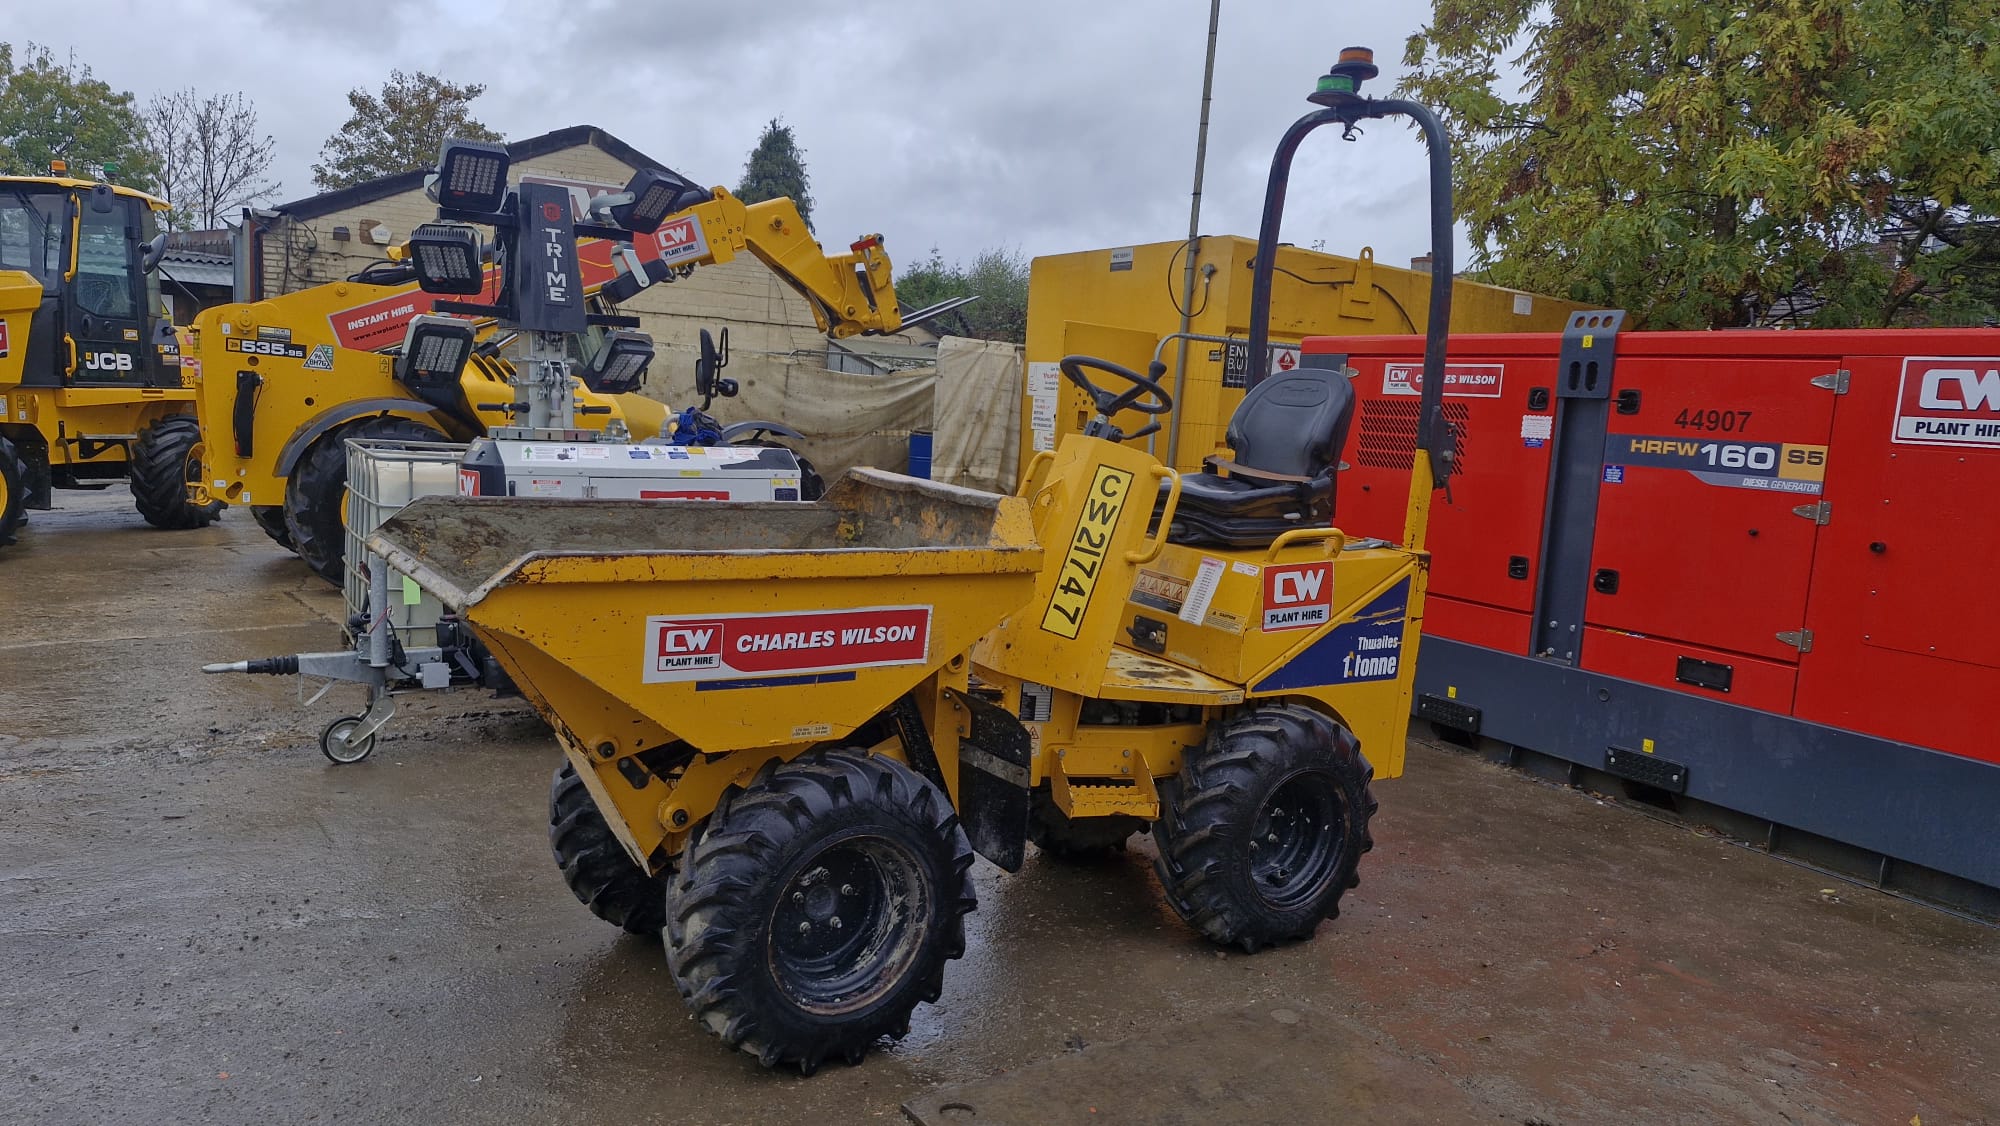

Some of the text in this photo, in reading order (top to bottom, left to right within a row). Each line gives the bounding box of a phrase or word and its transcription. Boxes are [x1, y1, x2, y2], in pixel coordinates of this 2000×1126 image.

[657, 225, 687, 248] CW
[546, 228, 567, 302] TRIME
[347, 304, 415, 331] INSTANT HIRE
[86, 352, 133, 371] JCB
[1458, 375, 1496, 385] WILSON
[1919, 369, 2000, 411] CW
[1674, 408, 1752, 432] 44907
[1914, 421, 2000, 438] PLANT HIR
[1630, 439, 1824, 470] HRFW 160 S5
[1742, 477, 1820, 493] DIESEL GENERATOR
[1053, 474, 1122, 626] CW21747
[1273, 568, 1326, 604] CW
[1270, 609, 1323, 624] PLANT HIRE
[665, 628, 714, 653] CW
[736, 625, 916, 653] CHARLES WILSON
[1358, 635, 1399, 651] Thwaites
[665, 655, 714, 667] PLANT HIRE
[1354, 655, 1397, 677] tonne
